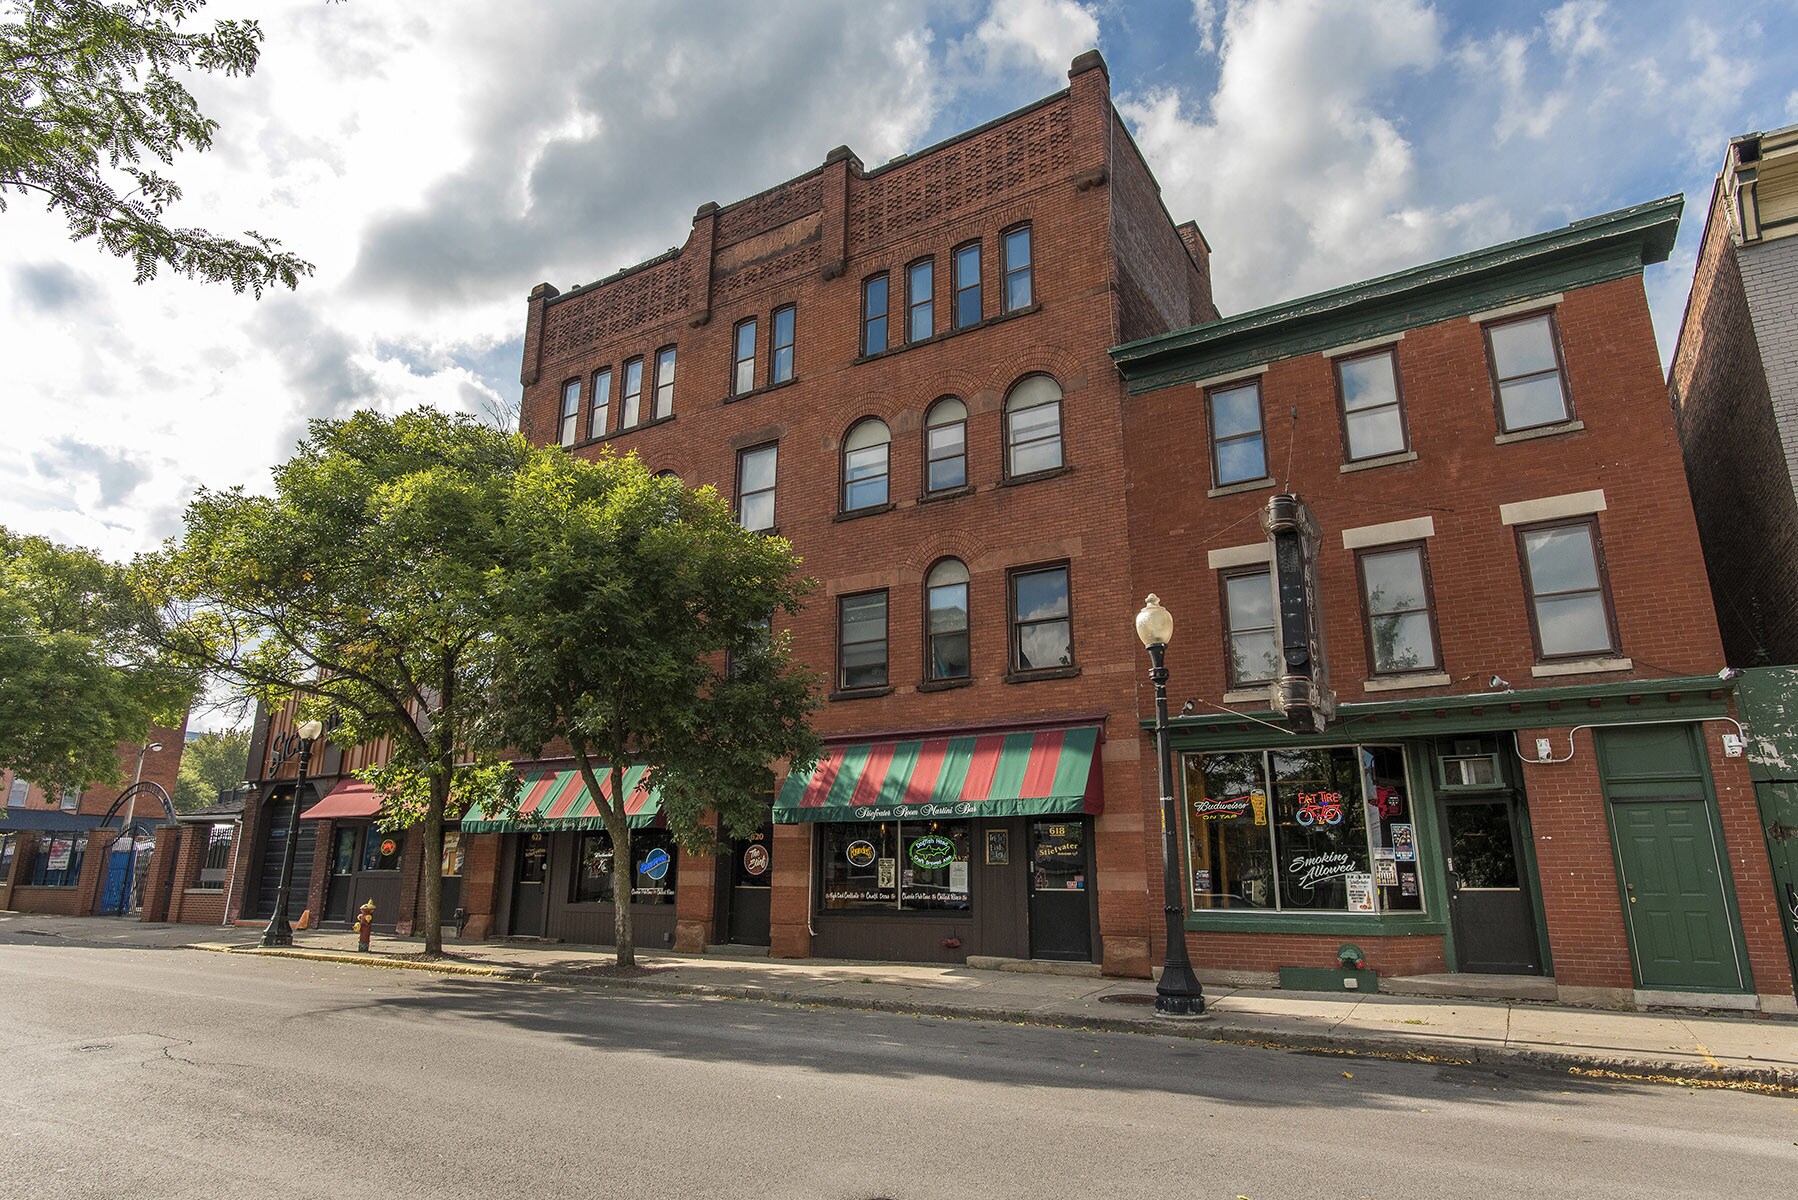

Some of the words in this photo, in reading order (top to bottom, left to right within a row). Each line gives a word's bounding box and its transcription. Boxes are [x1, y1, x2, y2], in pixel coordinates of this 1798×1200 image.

[1297, 792, 1318, 804] FAT
[1317, 791, 1340, 803] TIRE
[855, 805, 891, 820] Stiefvater
[893, 804, 919, 817] Room
[920, 803, 954, 817] Martini
[954, 801, 977, 815] Bar
[1194, 801, 1249, 812] Budweiser
[1049, 826, 1066, 835] 618
[531, 833, 542, 841] 622
[915, 838, 935, 848] Dogfish
[935, 838, 949, 847] Head
[749, 848, 761, 859] The
[1039, 843, 1079, 856] Stiefvater
[913, 854, 925, 864] Craft
[1289, 851, 1349, 873] Smoking
[1298, 861, 1357, 887] Allowed
